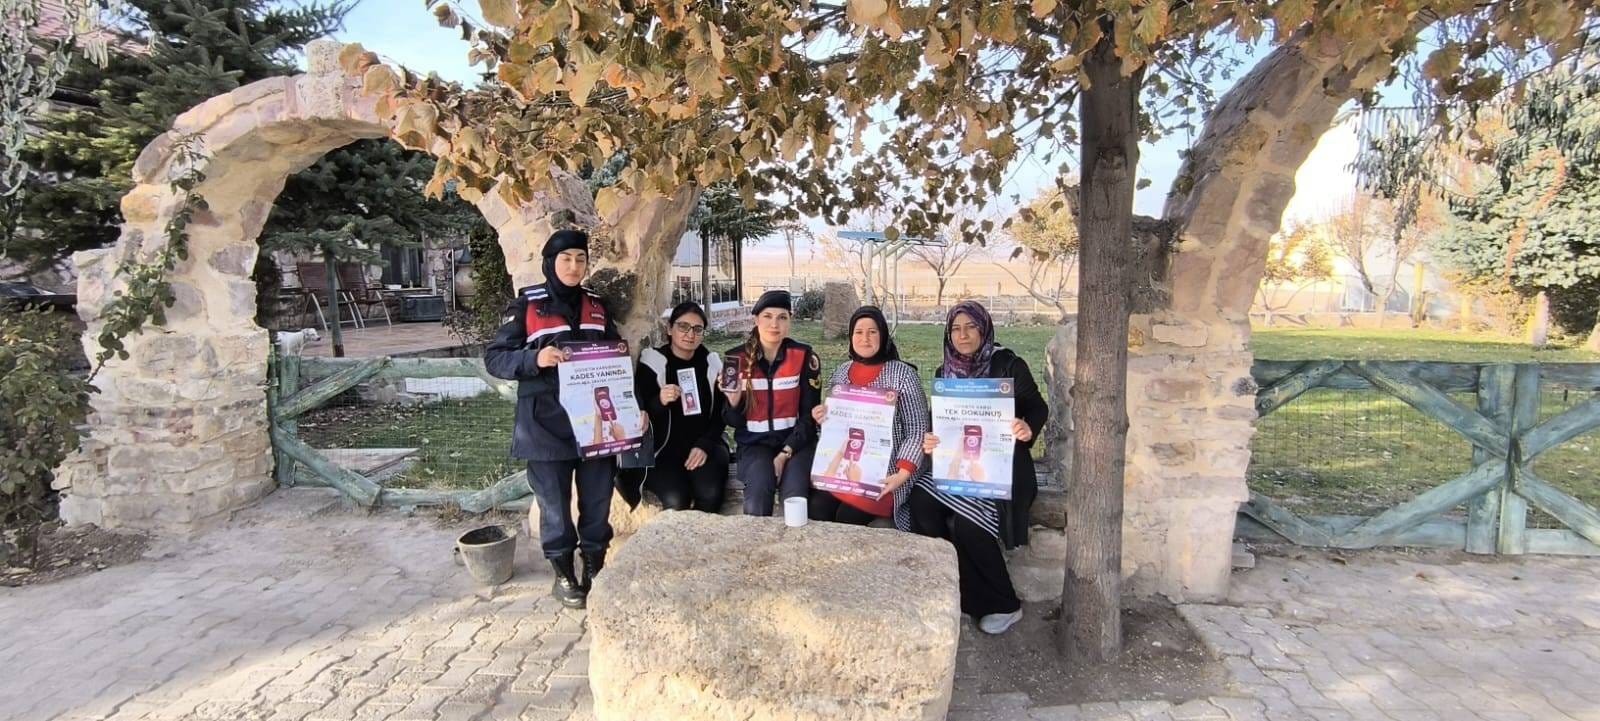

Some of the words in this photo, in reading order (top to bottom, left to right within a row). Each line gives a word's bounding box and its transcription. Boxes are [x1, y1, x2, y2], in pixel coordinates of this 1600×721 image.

[570, 372, 595, 380] KADES
[595, 369, 627, 378] YANINDA
[961, 409, 1002, 418] DOKUNUŞ
